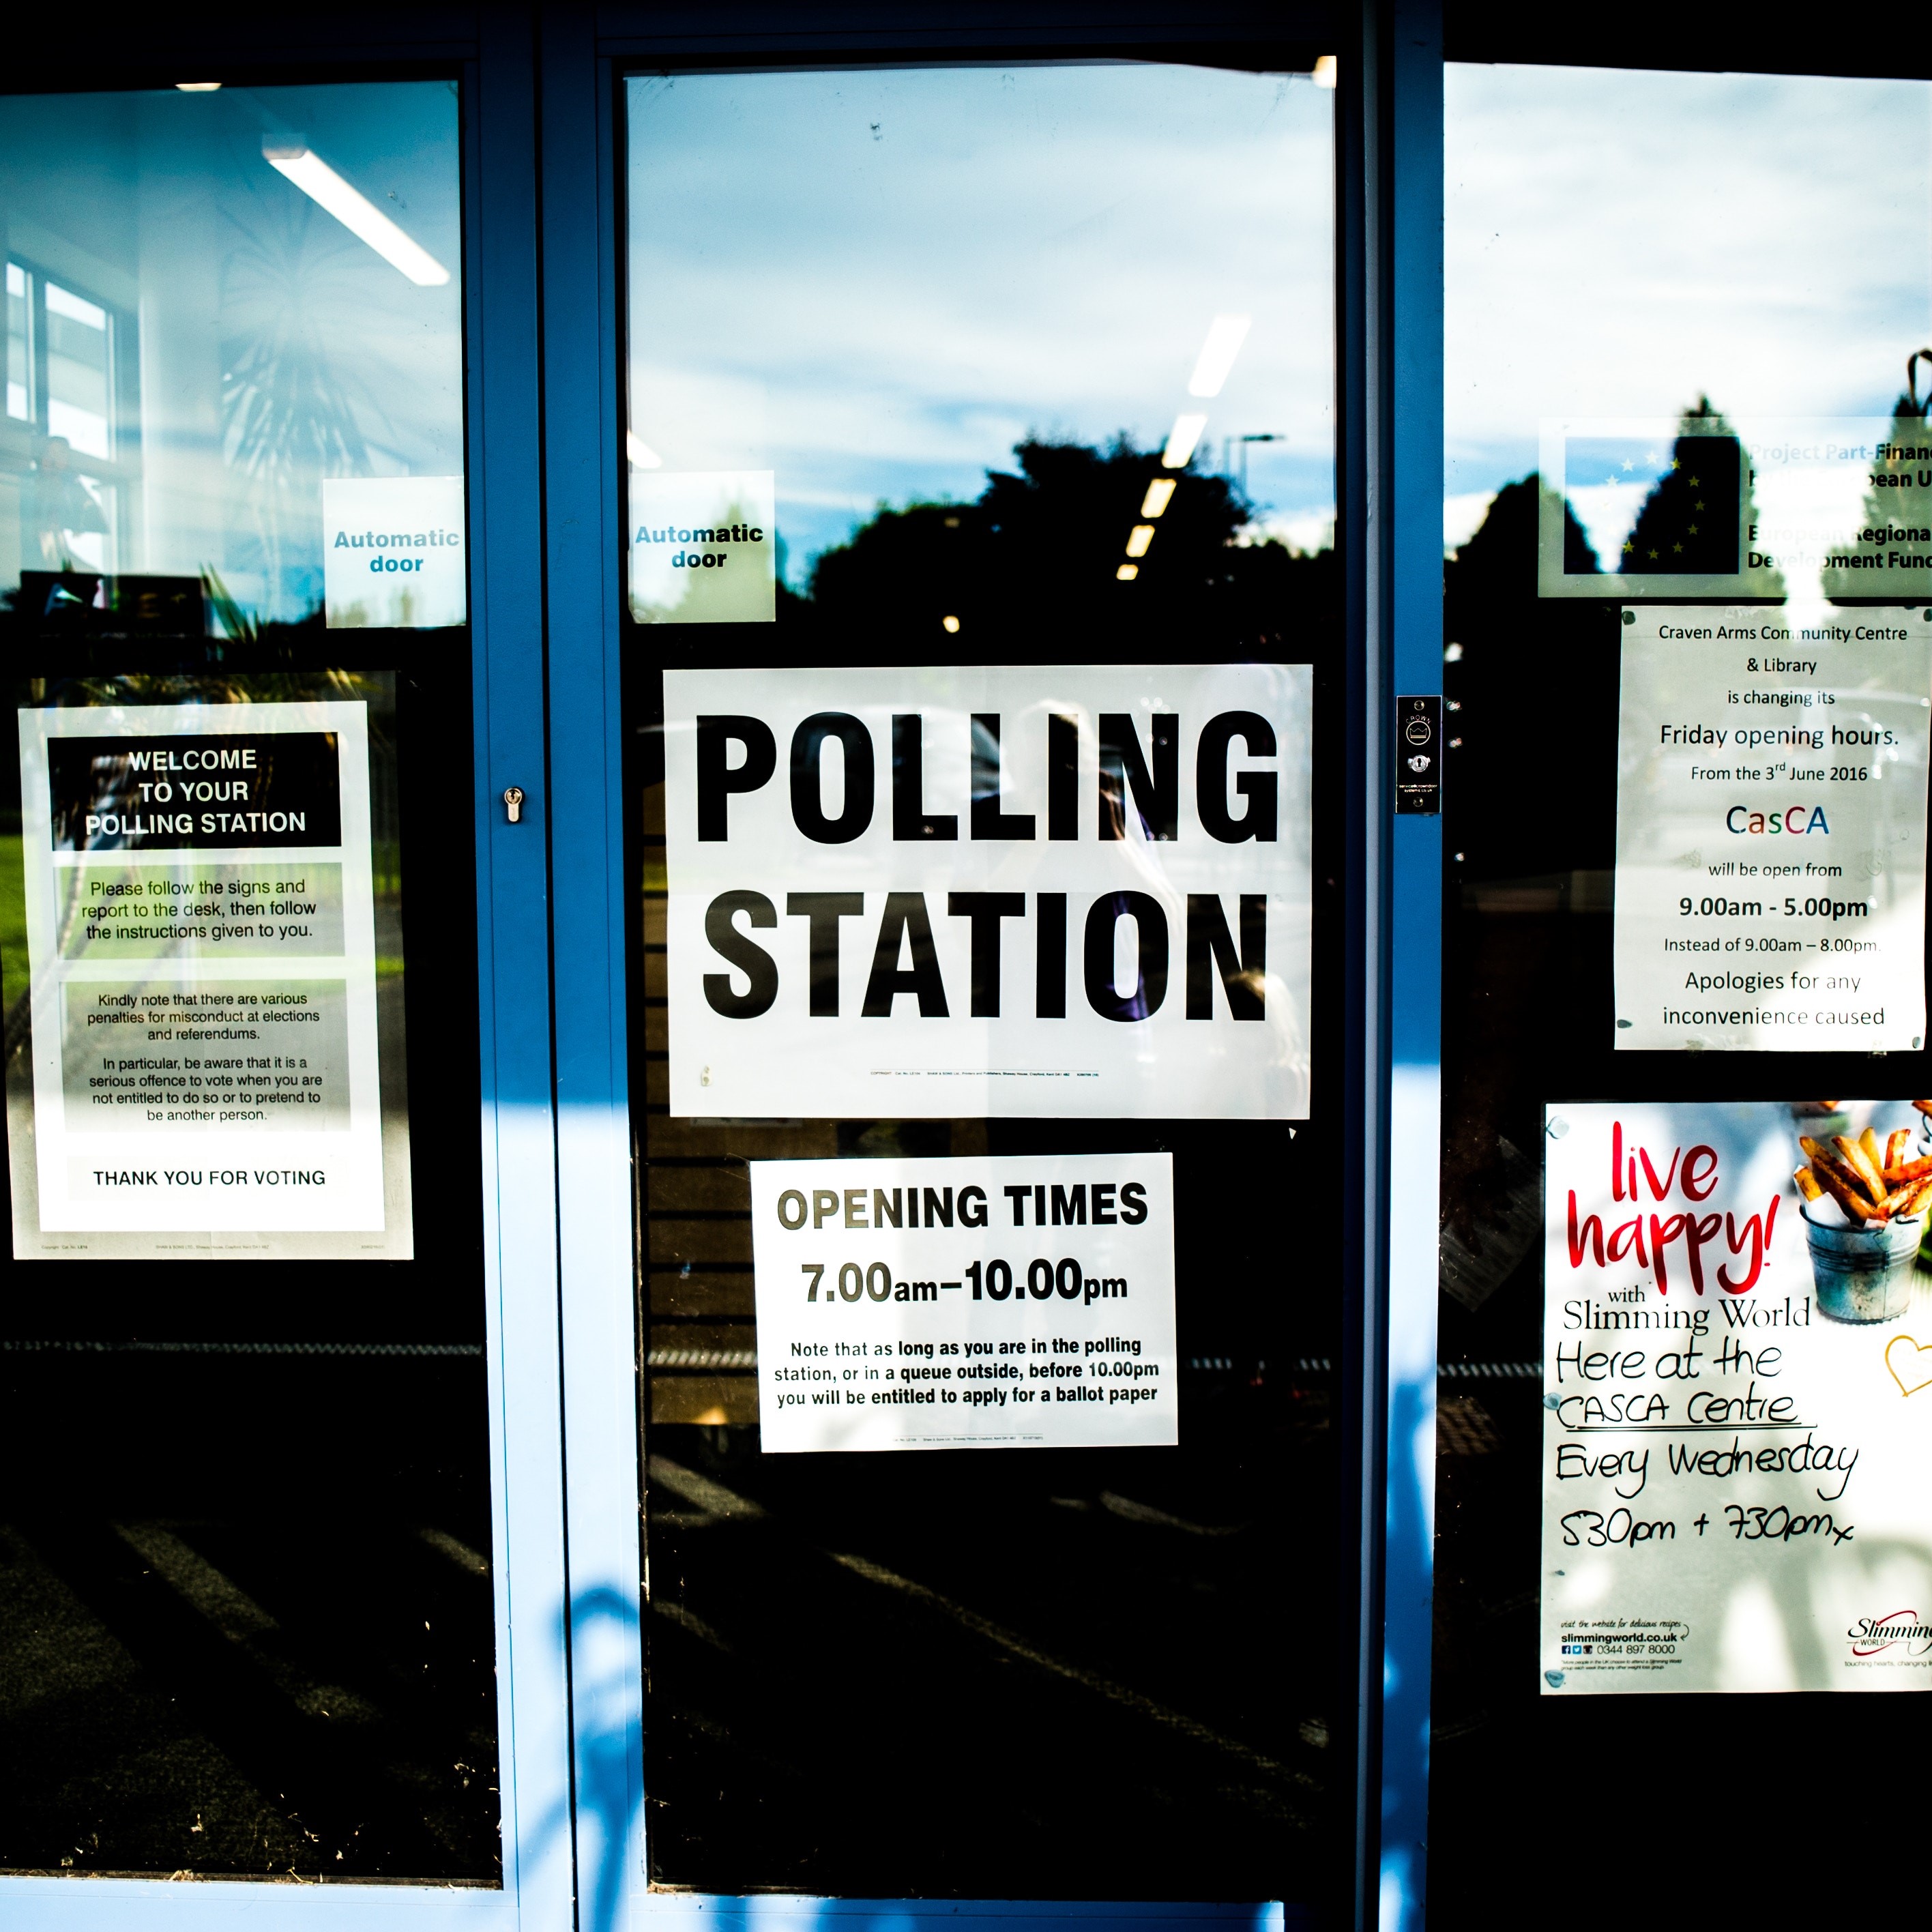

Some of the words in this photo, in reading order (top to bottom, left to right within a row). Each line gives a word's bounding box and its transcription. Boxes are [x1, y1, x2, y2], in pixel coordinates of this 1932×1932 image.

[1749, 443, 1819, 464] Project
[1826, 443, 1932, 460] Part-Finan
[334, 529, 459, 548] Automatic
[636, 524, 763, 543] Automatic
[370, 555, 423, 572] door
[672, 551, 727, 568] door
[1659, 626, 1712, 639] Craven
[1717, 626, 1756, 639] Arms
[1855, 626, 1907, 640] Centre
[1747, 658, 1759, 671] &
[1765, 658, 1817, 675] Library
[1729, 690, 1738, 703] is
[1744, 690, 1812, 707] changing
[1818, 691, 1834, 704] its
[1661, 724, 1727, 748] Friday
[1736, 726, 1824, 749] opening
[1832, 725, 1898, 745] hours.
[129, 750, 257, 772] WELCOME
[696, 710, 1278, 845] POLLING
[1692, 767, 1730, 780] From
[1736, 766, 1760, 780] the
[1789, 767, 1824, 780] June
[1830, 767, 1867, 780] 2016
[139, 782, 172, 802] TO
[180, 782, 248, 802] YOUR
[85, 815, 193, 835] POLLING
[201, 812, 306, 832] STATION
[1727, 806, 1829, 834] CasCA
[1709, 862, 1733, 875] will
[1740, 862, 1757, 875] be
[1763, 866, 1800, 879] open
[1806, 863, 1841, 876] from
[91, 882, 143, 896] Please
[147, 881, 194, 895] follow
[199, 880, 223, 894] the
[229, 880, 270, 897] signs
[276, 879, 304, 893] and
[83, 904, 128, 921] report
[133, 904, 148, 917] to
[153, 903, 177, 916] the
[184, 902, 224, 918] desk,
[230, 901, 265, 916] then
[270, 901, 316, 915] follow
[1680, 898, 1761, 916] 9.00am
[1785, 898, 1867, 921] 5.00pm
[87, 925, 111, 939] the
[117, 924, 206, 939] instructions
[211, 923, 253, 941] given
[259, 924, 274, 937] to
[279, 926, 312, 940] you.
[1665, 938, 1719, 951] Instead
[1725, 938, 1740, 951] of
[1746, 939, 1801, 951] 9.00am
[703, 890, 1267, 1022] STATION
[1686, 971, 1784, 993] Apologies
[1791, 971, 1819, 989] for
[1827, 978, 1860, 993] any
[99, 995, 137, 1008] Kindly
[142, 995, 169, 1006] note
[173, 994, 197, 1005] that
[201, 994, 233, 1005] there
[237, 996, 257, 1004] are
[261, 995, 307, 1004] various
[88, 1012, 144, 1026] penalties
[148, 1011, 165, 1023] for
[169, 1010, 244, 1023] misconduct
[248, 1011, 259, 1022] at
[263, 1010, 319, 1022] elections
[1664, 1007, 1807, 1024] inconvenience
[1816, 1008, 1884, 1024] caused
[148, 1029, 171, 1040] and
[177, 1028, 259, 1040] referendums.
[1612, 1121, 1718, 1202] live
[93, 1171, 158, 1185] THANK
[164, 1171, 202, 1185] YOU
[210, 1171, 247, 1185] FOR
[254, 1171, 325, 1185] VOTING
[778, 1186, 988, 1230] OPENING
[1004, 1182, 1147, 1226] TIMES
[1568, 1190, 1781, 1296] happy!
[1608, 1285, 1645, 1303] with
[1564, 1298, 1710, 1336] Slimming
[1718, 1296, 1811, 1328] World
[791, 1343, 828, 1356] Note
[835, 1343, 867, 1356] that
[875, 1345, 892, 1356] as
[899, 1341, 933, 1359] long
[940, 1343, 958, 1355] as
[964, 1343, 993, 1358] you
[999, 1343, 1026, 1354] are
[1032, 1338, 1046, 1353] in
[1052, 1338, 1079, 1353] the
[1085, 1337, 1141, 1357] polling
[1556, 1341, 1645, 1384] Here
[1655, 1335, 1703, 1379] at
[1713, 1335, 1782, 1378] the
[775, 1366, 836, 1383] station,
[843, 1370, 858, 1380] or
[865, 1366, 878, 1379] in
[886, 1369, 894, 1379] a
[901, 1368, 951, 1384] queue
[957, 1363, 1023, 1381] outside,
[1029, 1362, 1082, 1377] before
[1089, 1362, 1158, 1380] 10.00pm
[778, 1394, 804, 1409] you
[812, 1390, 839, 1404] will
[847, 1390, 865, 1404] be
[872, 1388, 935, 1404] entitled
[941, 1389, 956, 1403] to
[963, 1388, 1007, 1407] apply
[1012, 1387, 1035, 1402] for
[1041, 1390, 1050, 1402] a
[1057, 1386, 1104, 1401] ballot
[1110, 1389, 1157, 1405] paper
[1556, 1394, 1670, 1428] CASCA
[1687, 1381, 1798, 1424] Centre
[1556, 1444, 1649, 1499] Every
[1669, 1432, 1859, 1502] Wednesday
[1579, 1619, 1589, 1628] the
[1592, 1619, 1616, 1628] website
[1618, 1618, 1628, 1629] for
[1630, 1618, 1656, 1628] delicious
[1659, 1620, 1681, 1631] recipes
[1847, 1618, 1932, 1650] Slimmin
[1561, 1633, 1678, 1644] slimmingworld.co.uk
[1597, 1645, 1622, 1654] 0344
[1626, 1645, 1645, 1654] 897
[1648, 1645, 1675, 1654] 8000
